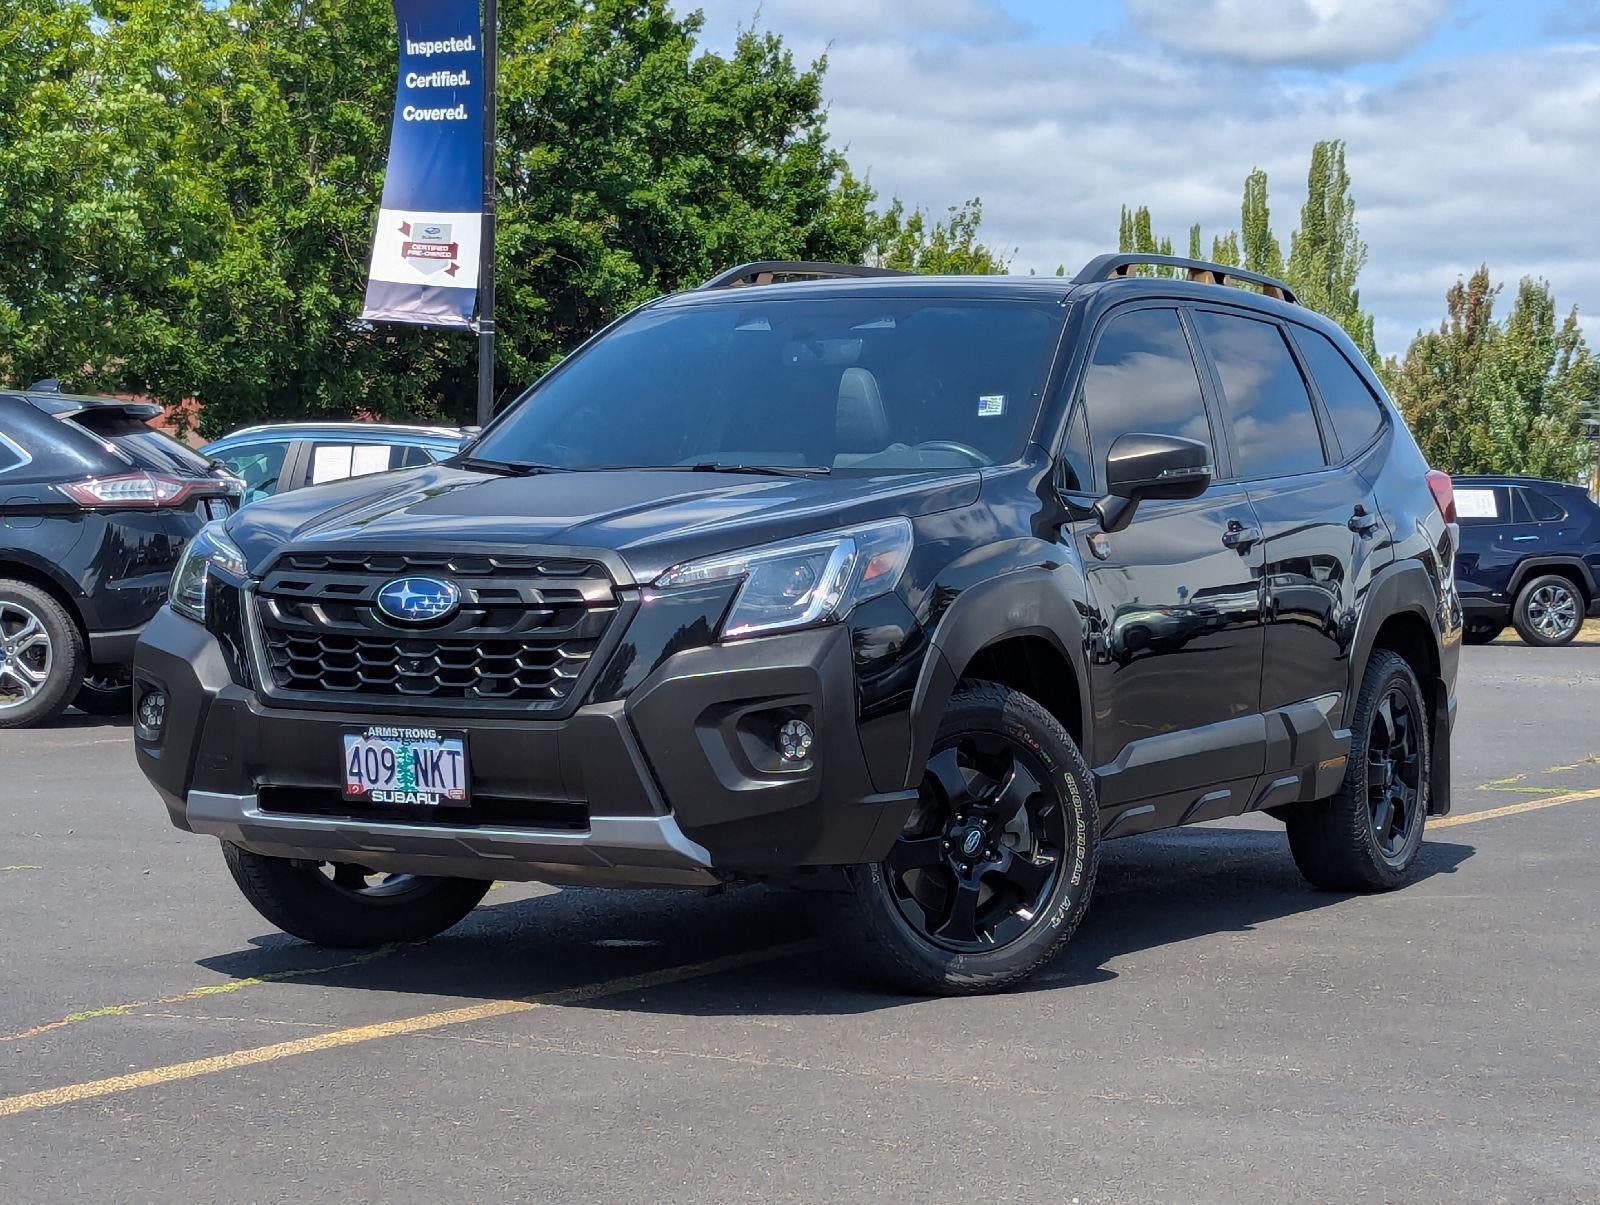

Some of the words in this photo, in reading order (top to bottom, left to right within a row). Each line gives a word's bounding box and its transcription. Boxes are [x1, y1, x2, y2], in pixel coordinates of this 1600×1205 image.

[406, 35, 476, 58] Inspected.
[405, 70, 471, 88] Certified.
[402, 104, 468, 121] Covered.
[368, 726, 437, 739] ARMSTRONG
[349, 745, 396, 785] 409
[412, 748, 461, 789] NKT
[371, 790, 440, 806] SUBARU
